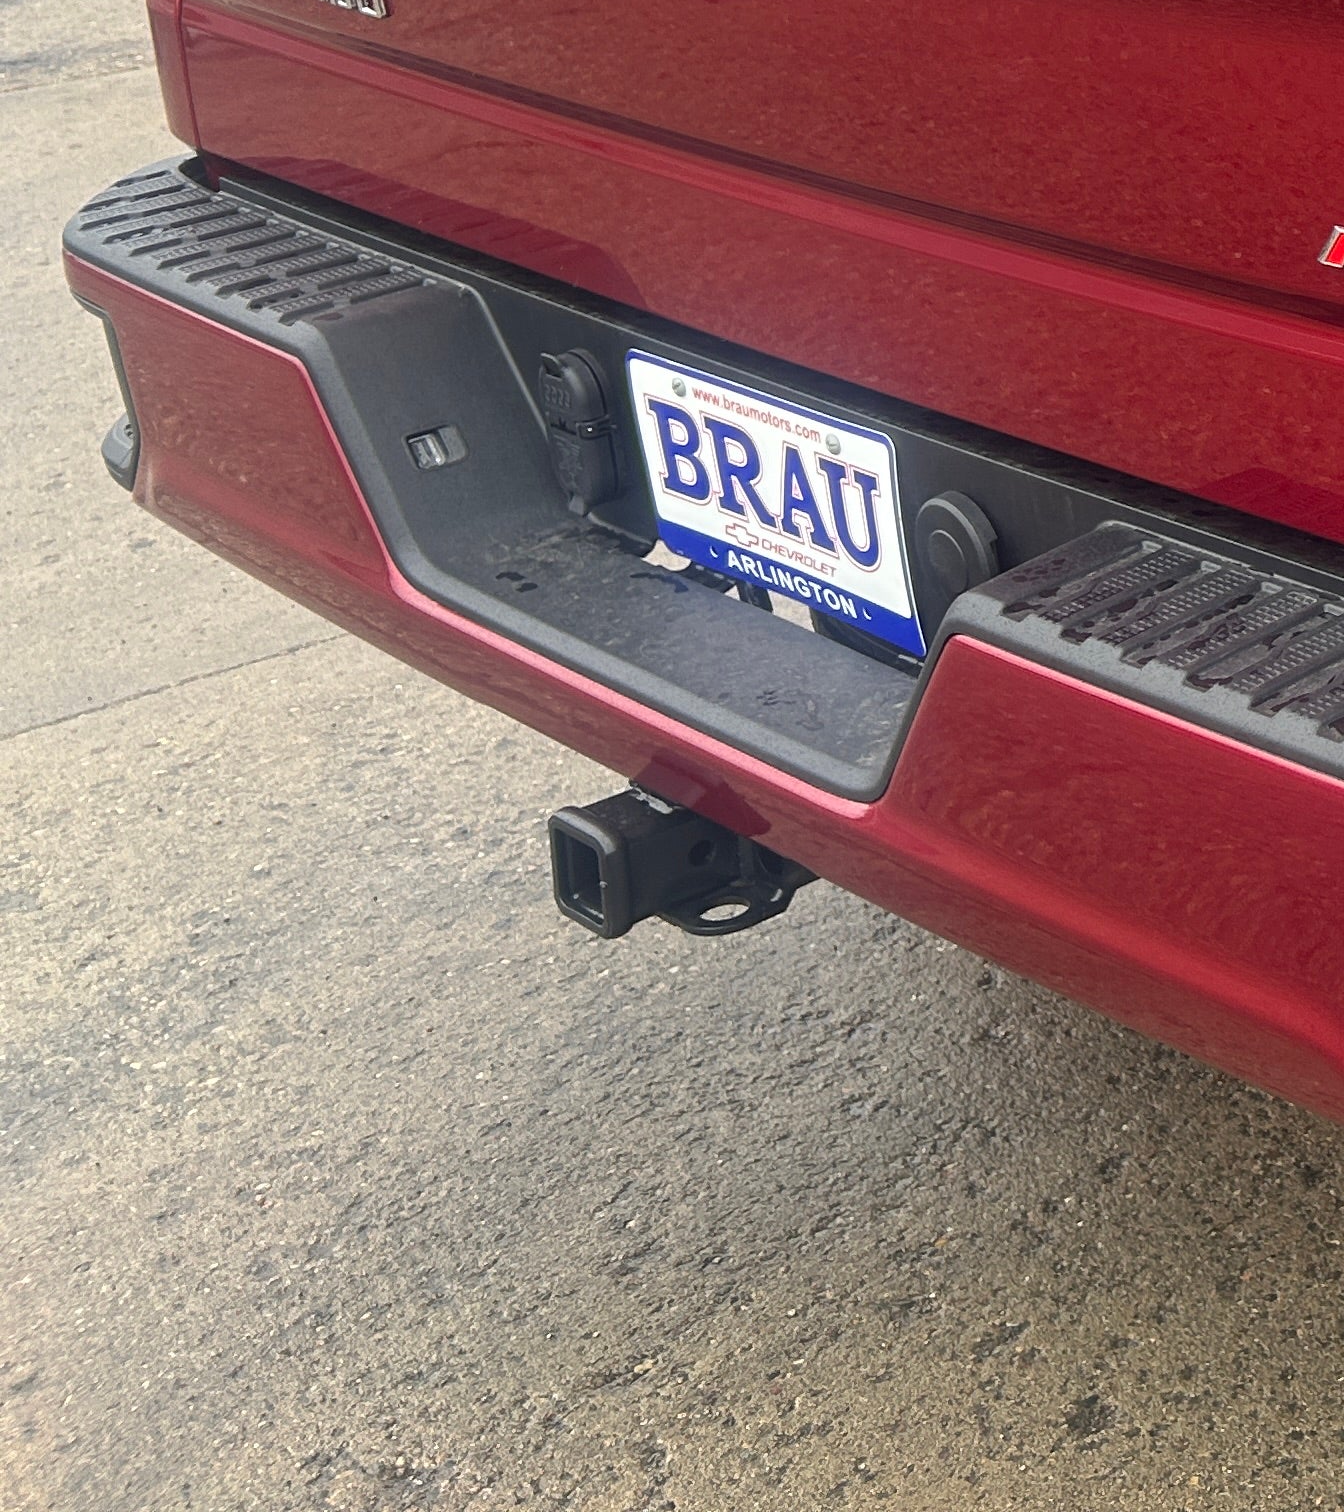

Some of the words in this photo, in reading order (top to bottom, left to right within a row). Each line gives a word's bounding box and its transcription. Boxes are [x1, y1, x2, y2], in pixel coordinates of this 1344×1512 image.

[692, 386, 822, 445] www.braumotors.com
[643, 393, 881, 573] BRAU
[727, 549, 858, 620] ARLINGTON
[761, 538, 837, 578] CHEVROLET
